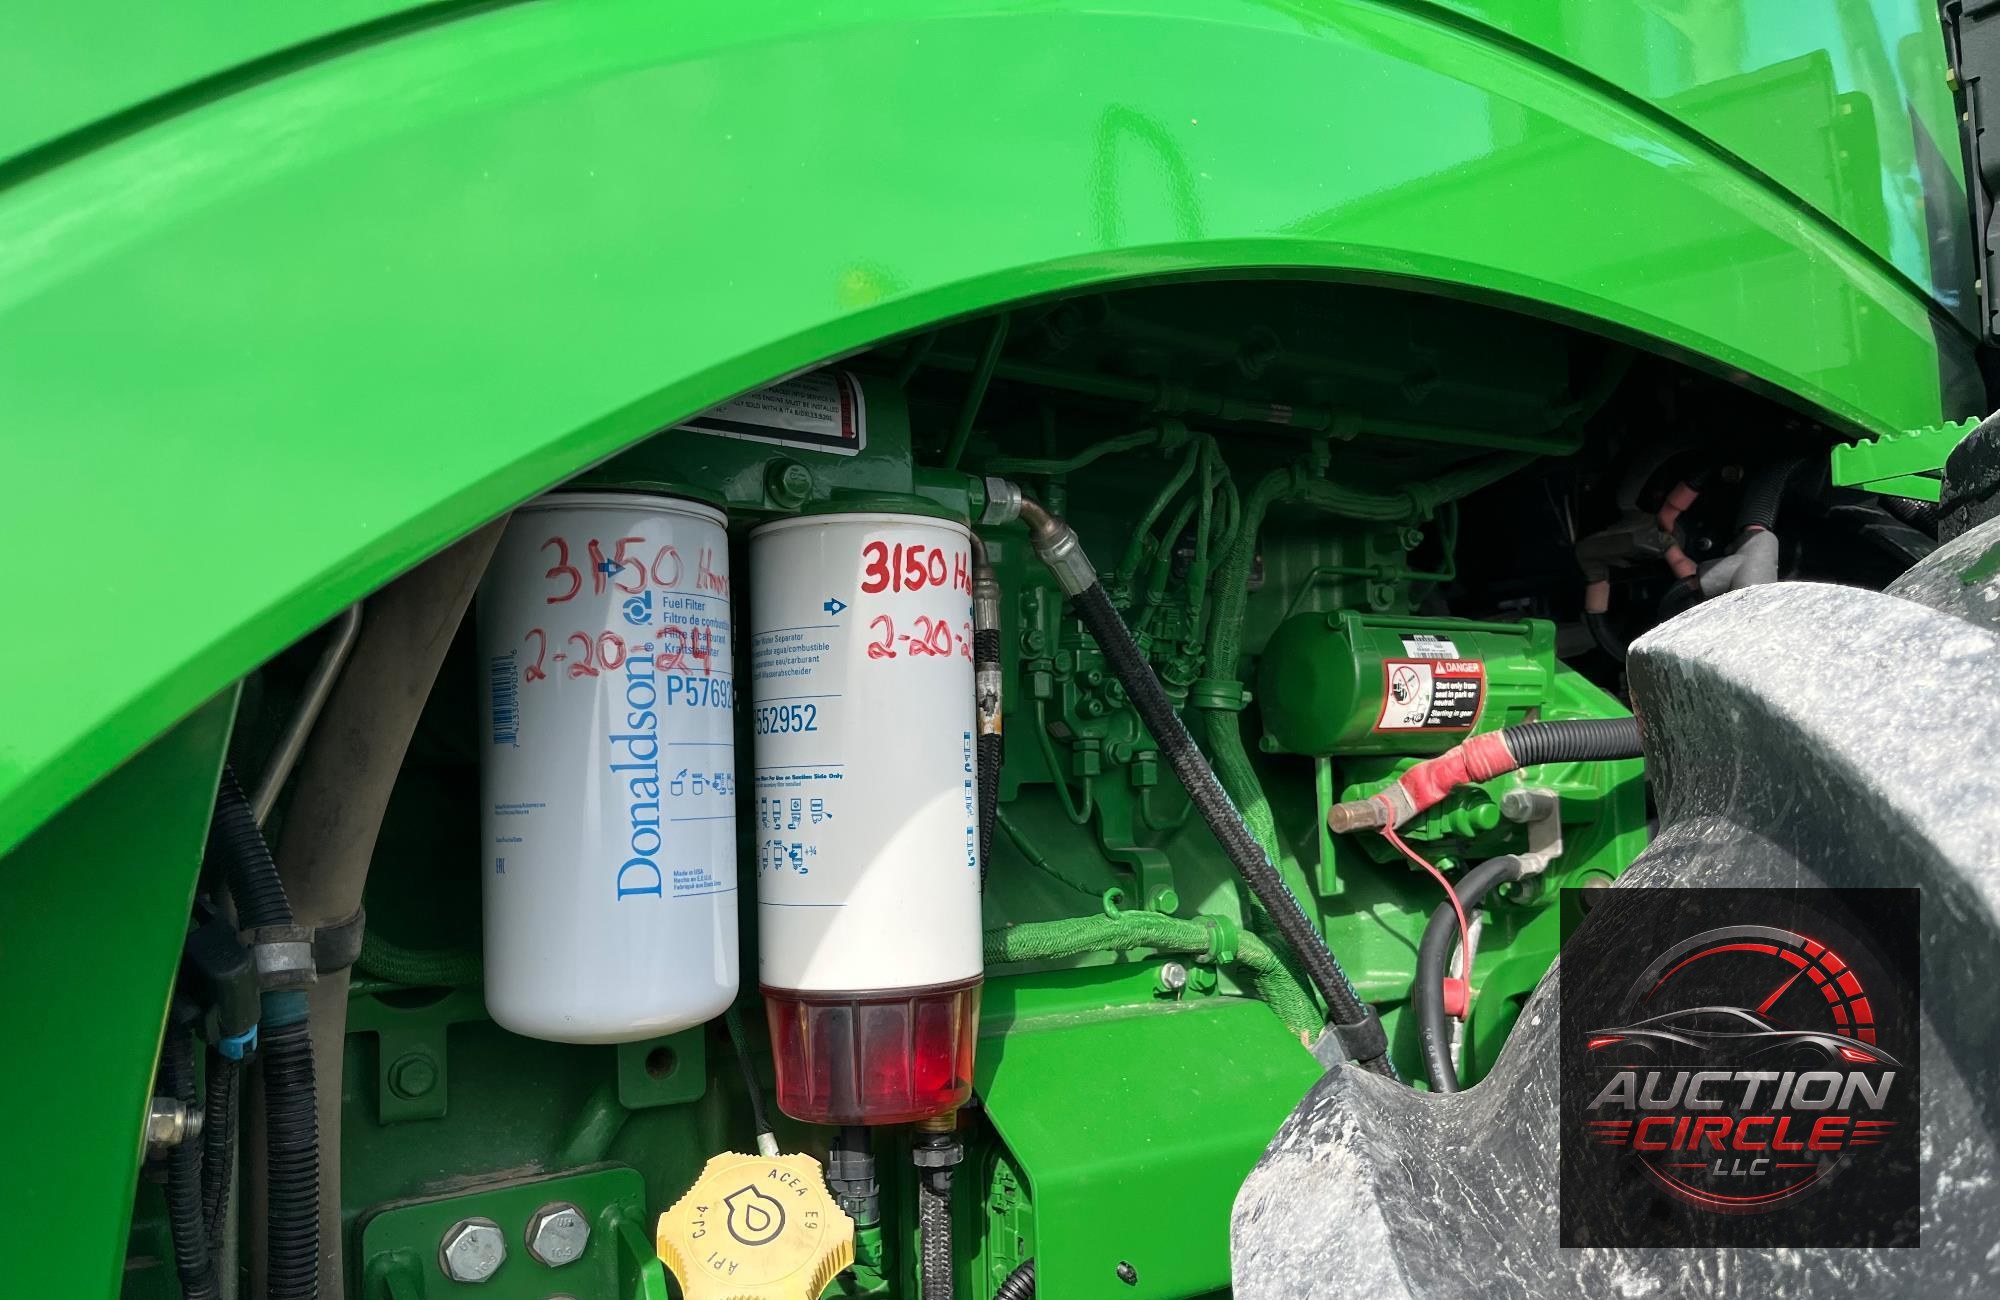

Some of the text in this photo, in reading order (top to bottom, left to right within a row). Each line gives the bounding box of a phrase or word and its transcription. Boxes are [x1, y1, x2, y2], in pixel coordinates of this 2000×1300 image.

[861, 541, 947, 593] 3150
[663, 597, 705, 611] Fuel Filter
[663, 612, 687, 624] Filtro
[690, 614, 699, 626] de
[775, 633, 804, 644] Separator
[1445, 662, 1480, 673] DANGER
[1435, 681, 1477, 691] Start only from
[1435, 691, 1448, 699] seat
[1467, 691, 1475, 699] or
[1430, 709, 1453, 719] Starting
[1459, 710, 1473, 719] gear
[608, 653, 662, 902] Donaldson
[829, 772, 844, 780] Only
[767, 1168, 808, 1197] ACEA
[692, 1205, 709, 1239] CJ-4
[804, 1211, 818, 1230] E9
[707, 1251, 739, 1276] API
